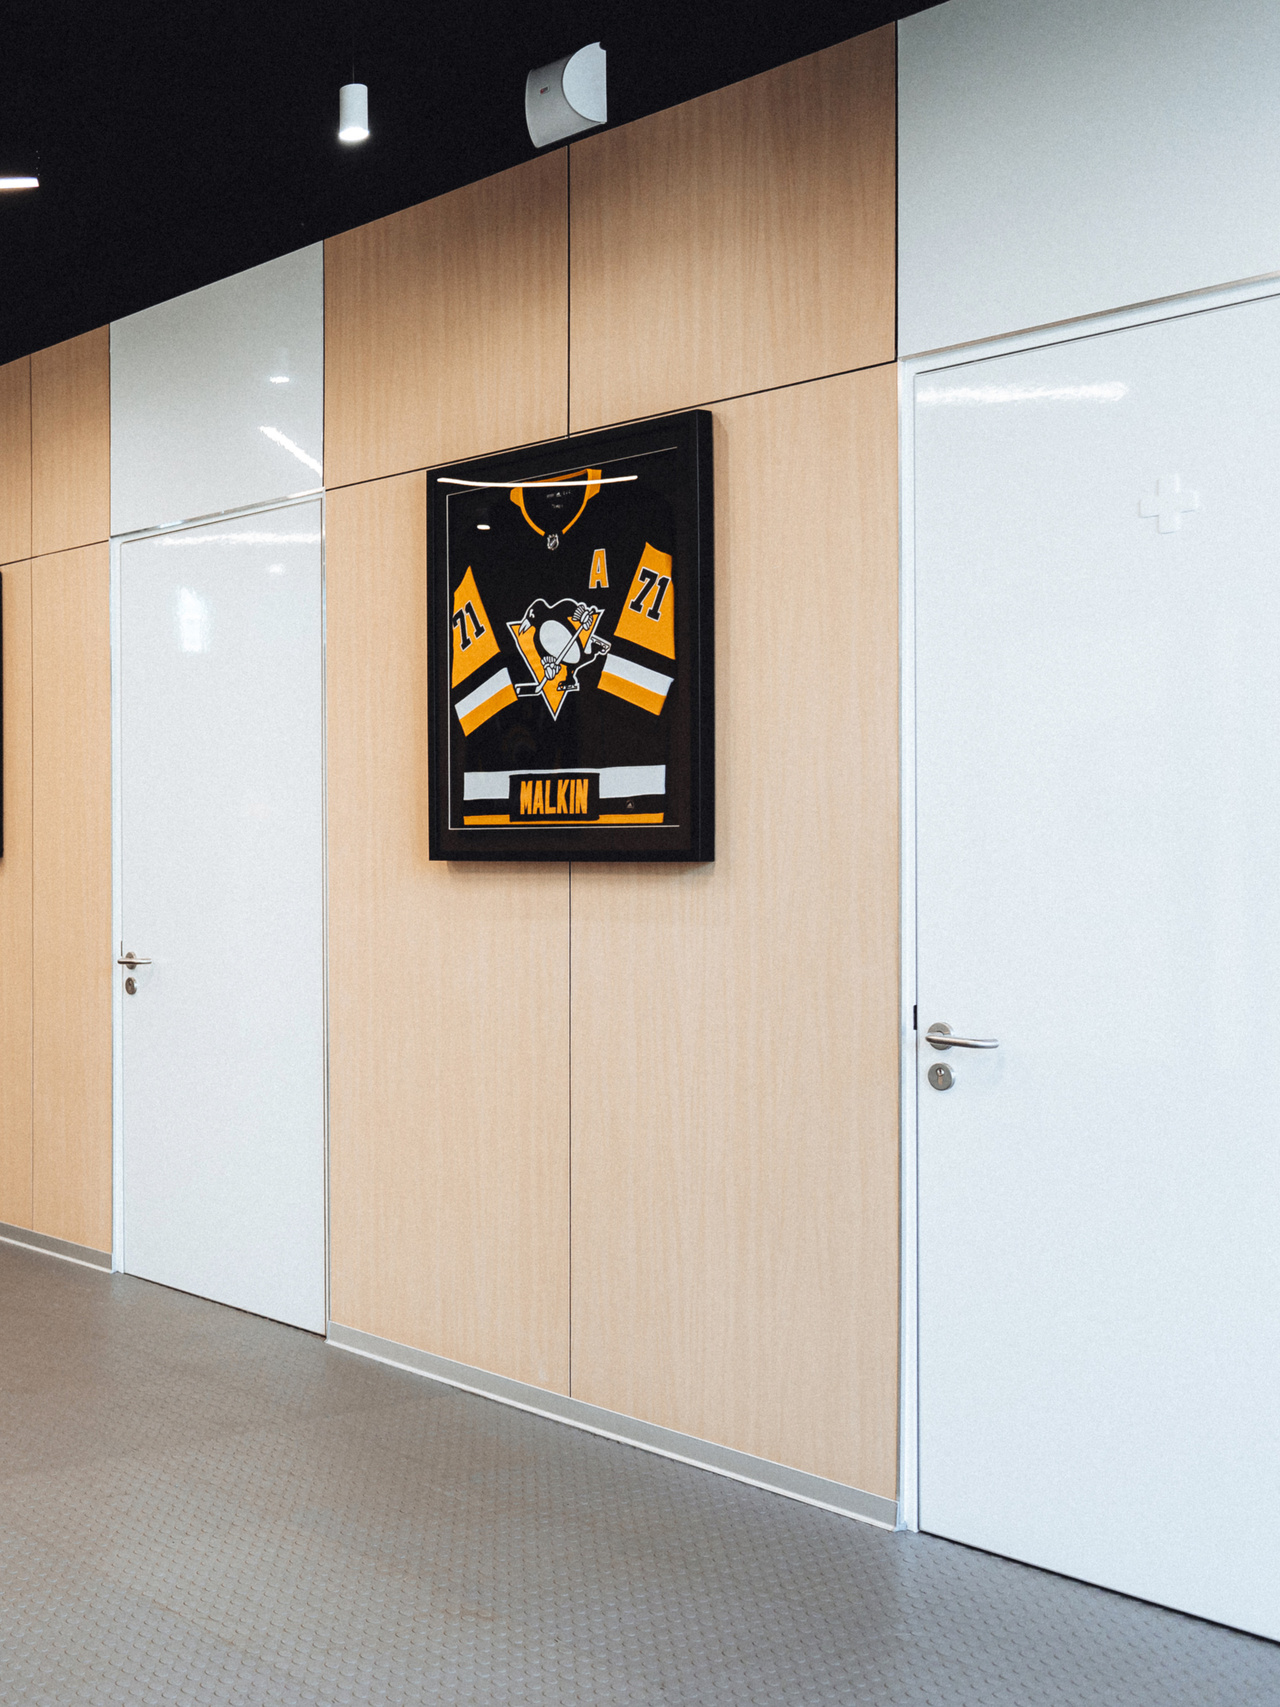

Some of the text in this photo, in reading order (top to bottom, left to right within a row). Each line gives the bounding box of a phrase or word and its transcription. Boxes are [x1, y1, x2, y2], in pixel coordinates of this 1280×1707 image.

[588, 548, 610, 590] A
[628, 566, 672, 622] 71
[452, 599, 487, 652] 71
[519, 778, 589, 815] MALKIN
